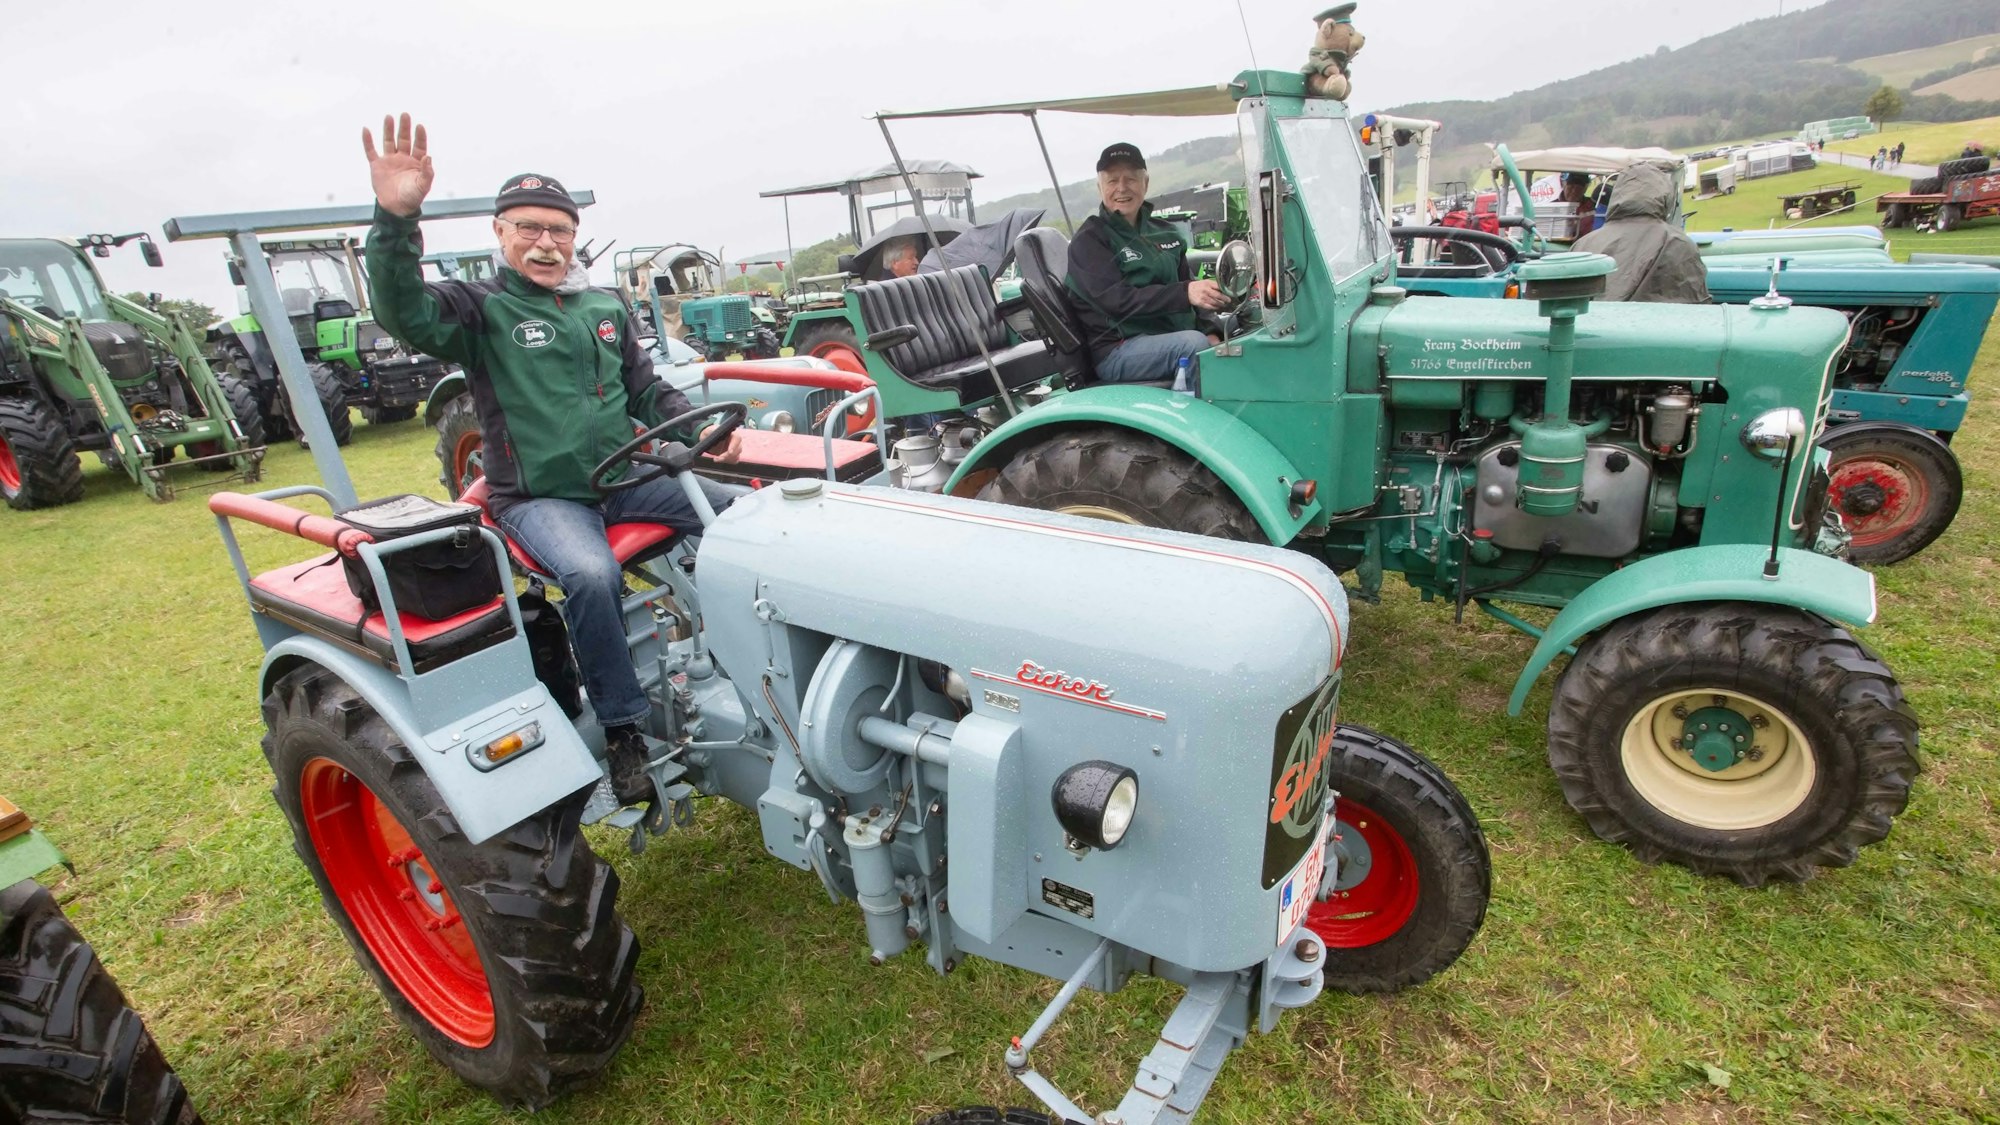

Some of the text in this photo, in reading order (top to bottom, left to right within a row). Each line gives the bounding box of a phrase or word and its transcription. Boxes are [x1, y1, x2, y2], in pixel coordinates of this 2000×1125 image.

[1160, 241, 1180, 249] MAN
[1422, 338, 1521, 352] Franz Bockheim
[1410, 359, 1442, 370] 51766
[1016, 660, 1115, 701] Eicher
[1270, 712, 1337, 824] Eich
